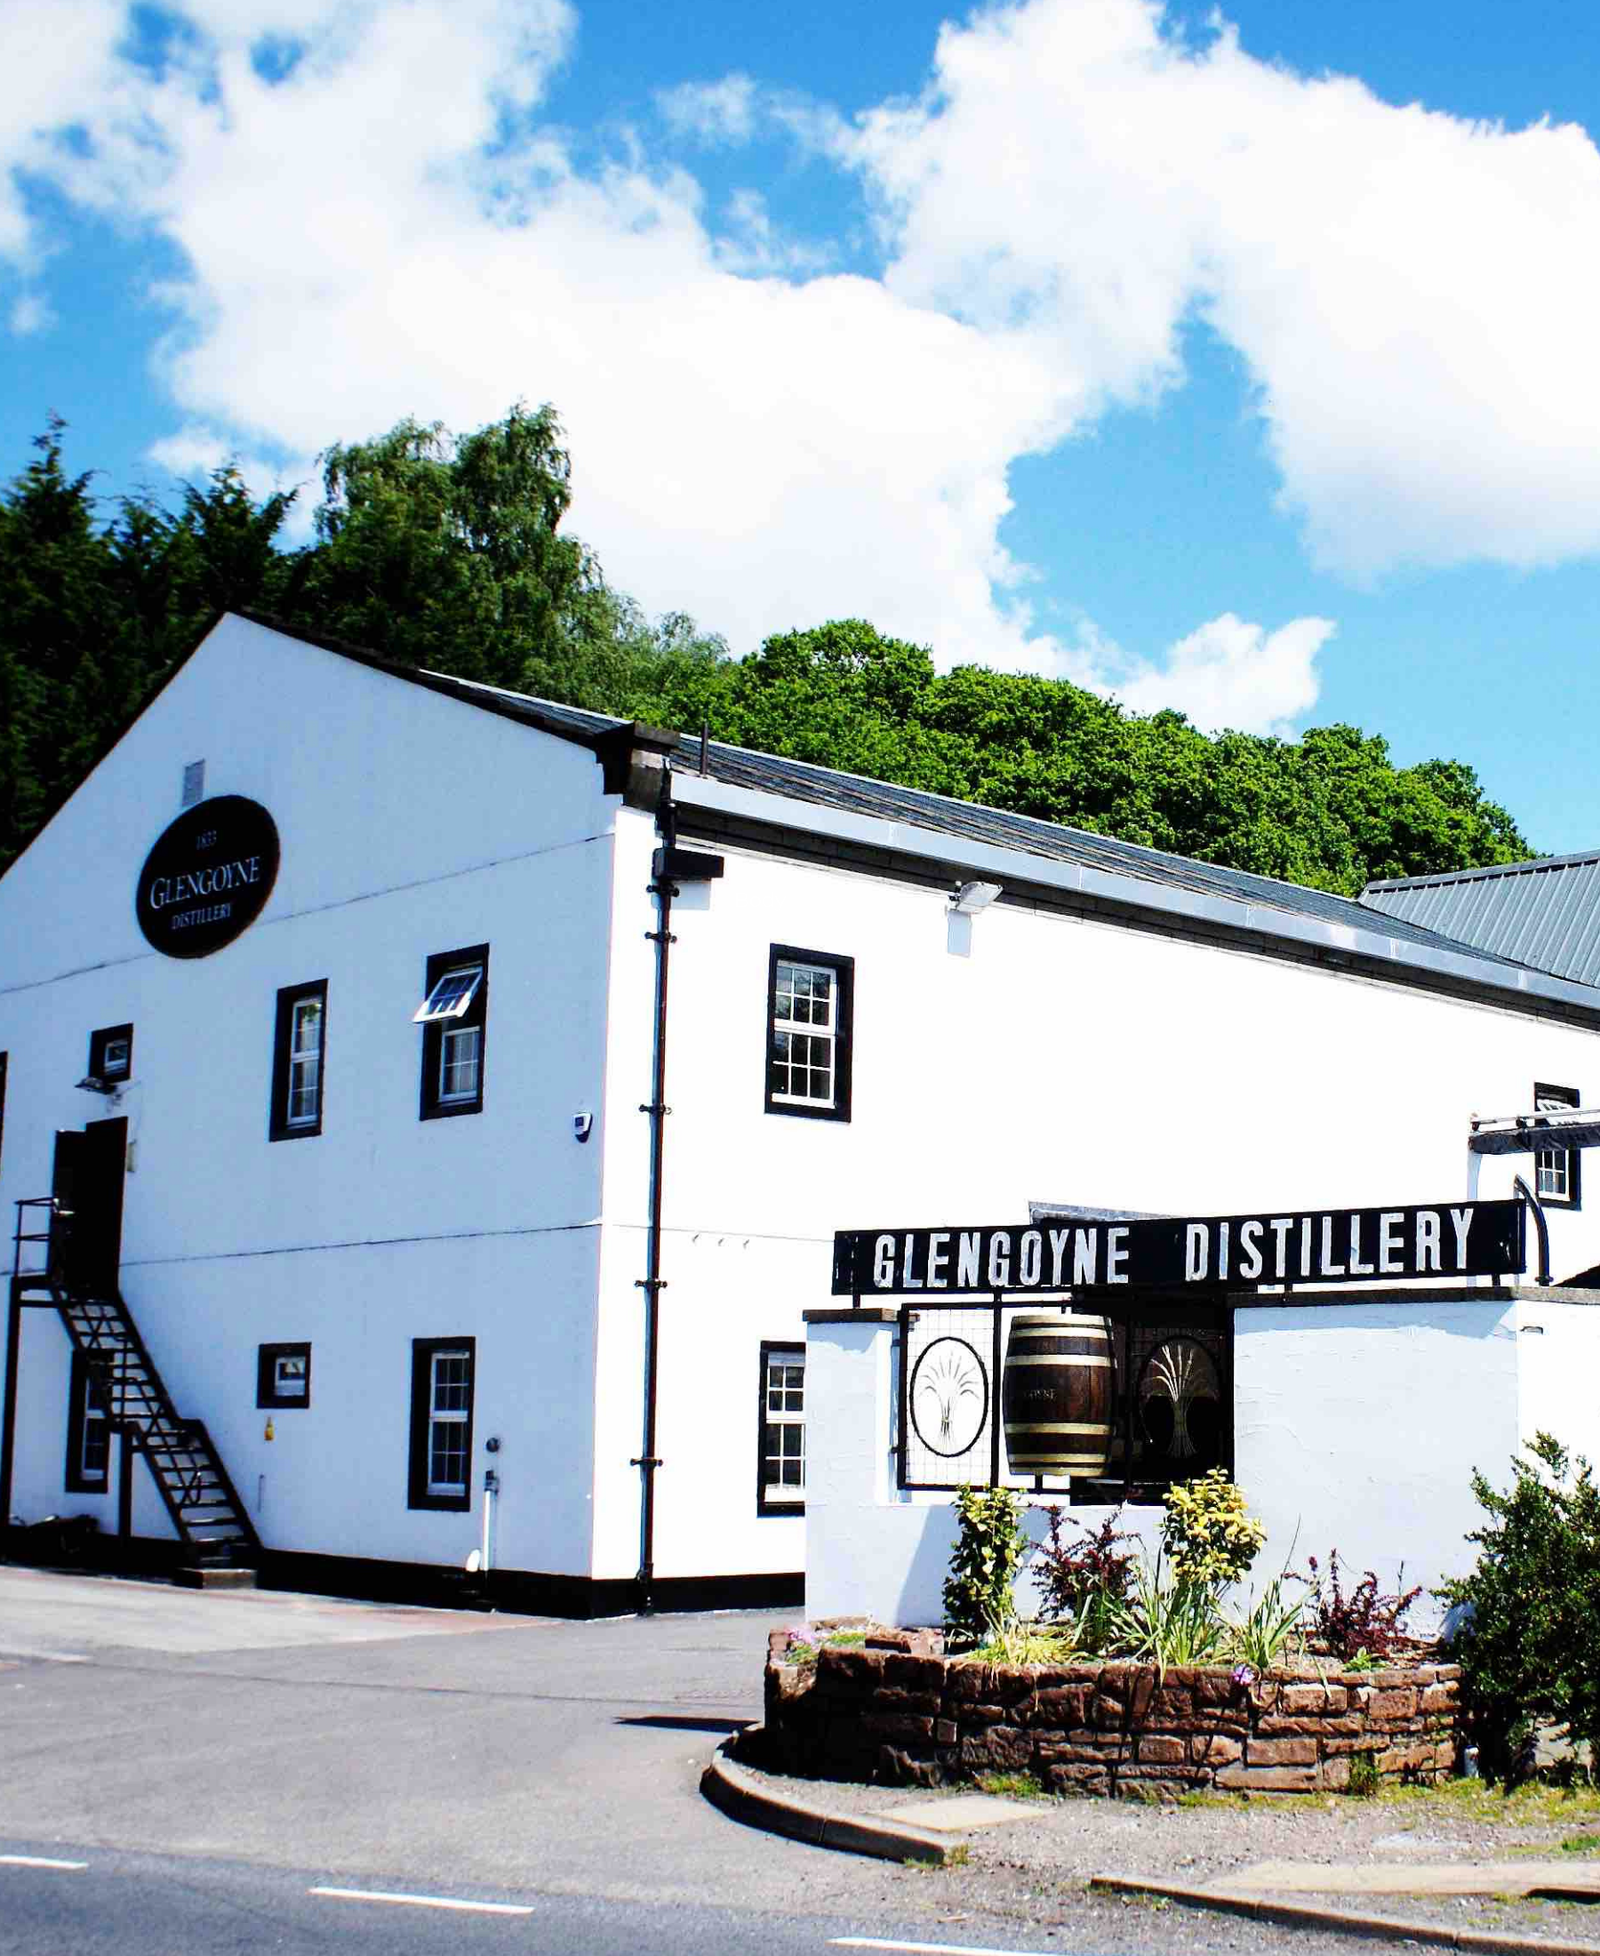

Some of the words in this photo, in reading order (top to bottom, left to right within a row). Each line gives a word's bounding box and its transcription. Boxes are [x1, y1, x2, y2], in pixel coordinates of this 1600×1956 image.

[150, 856, 261, 909] GLENGOYNE
[171, 903, 232, 930] DISTILLERY
[873, 1227, 1130, 1288] GLENGOYNE
[1185, 1208, 1474, 1281] DISTILLERY
